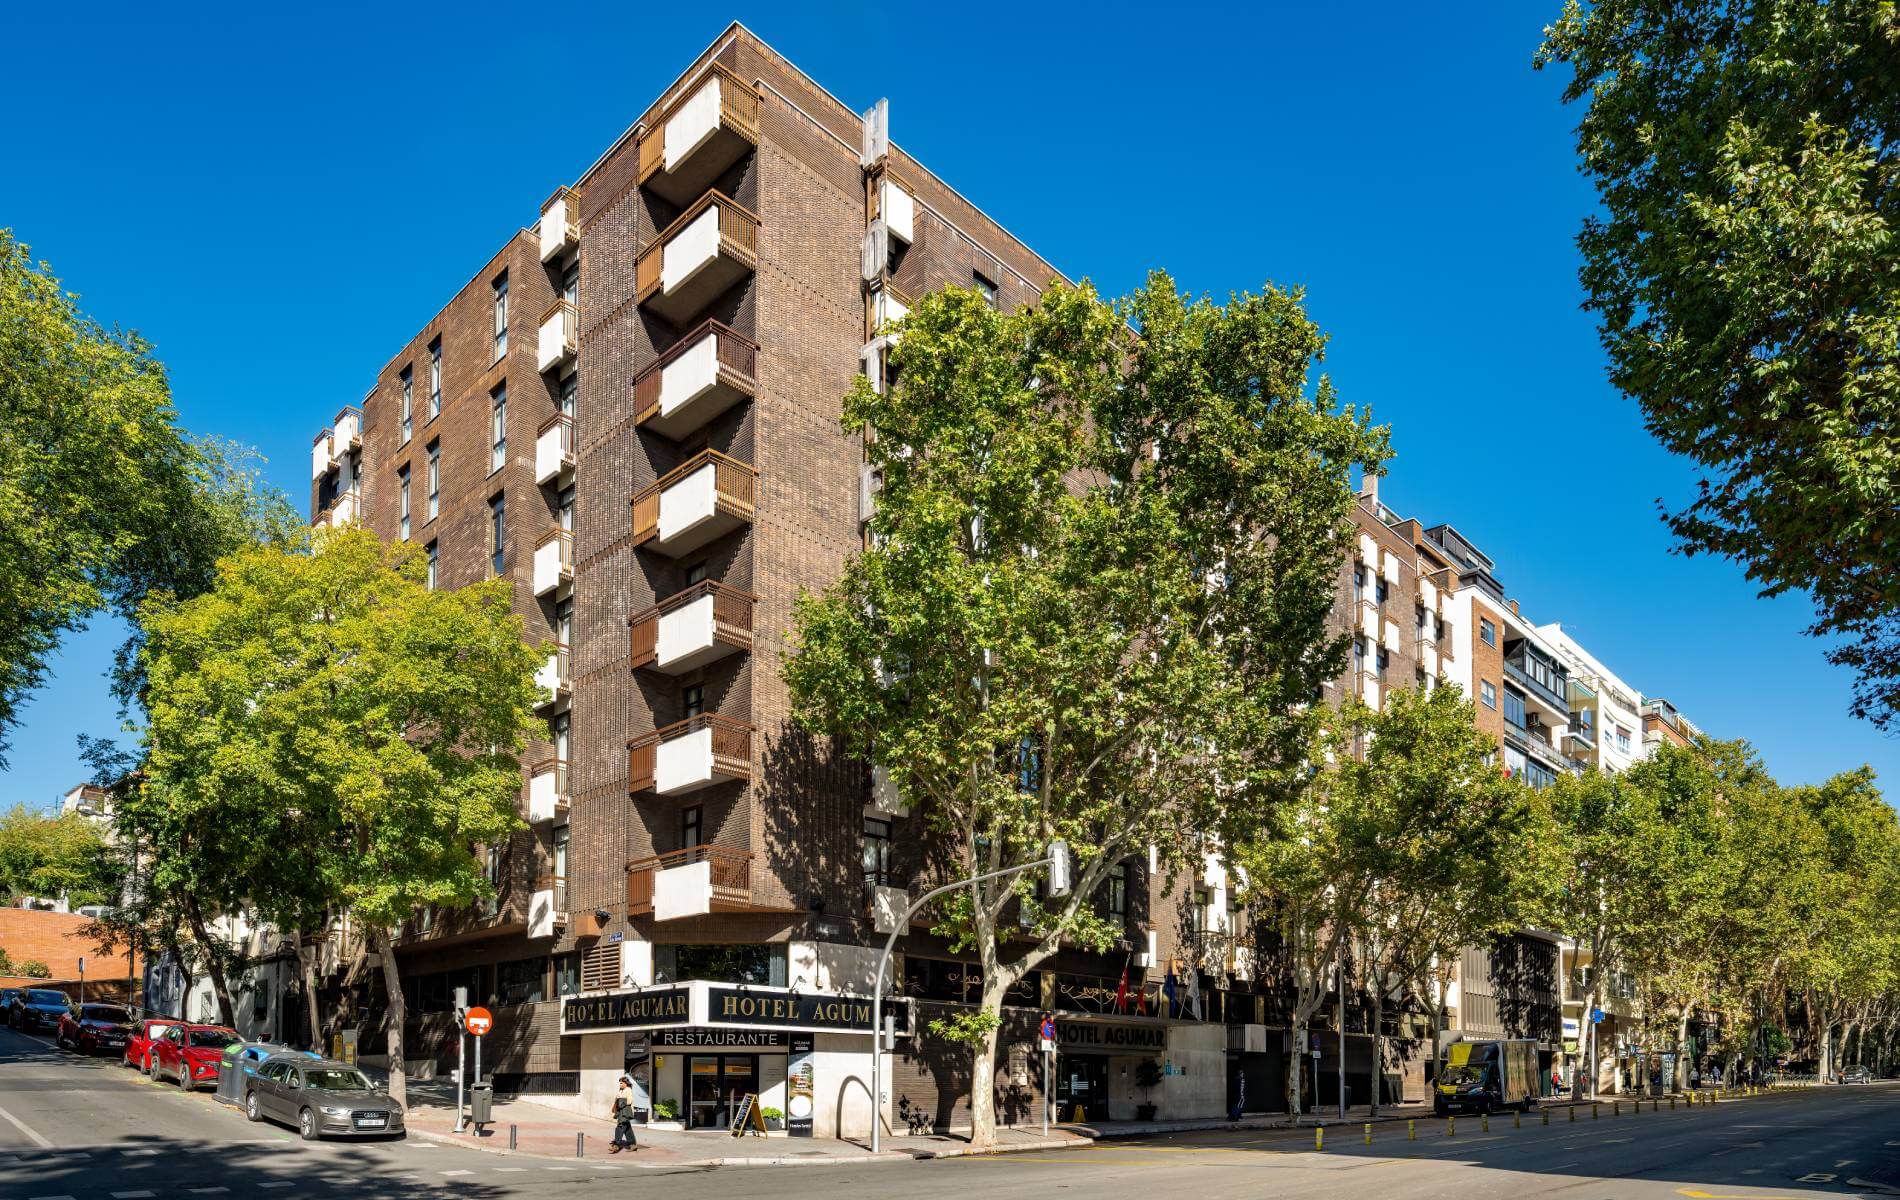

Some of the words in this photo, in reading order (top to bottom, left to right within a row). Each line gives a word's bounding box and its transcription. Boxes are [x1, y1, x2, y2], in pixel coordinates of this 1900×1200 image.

[567, 1002, 617, 1023] HOTEL
[622, 995, 687, 1019] AGUMAR
[722, 996, 800, 1019] HOTEL
[813, 1002, 897, 1024] AGUM
[664, 1033, 778, 1045] RESTAURANTE
[1056, 1024, 1100, 1043] HOTEL
[1104, 1026, 1164, 1047] AGUMAR
